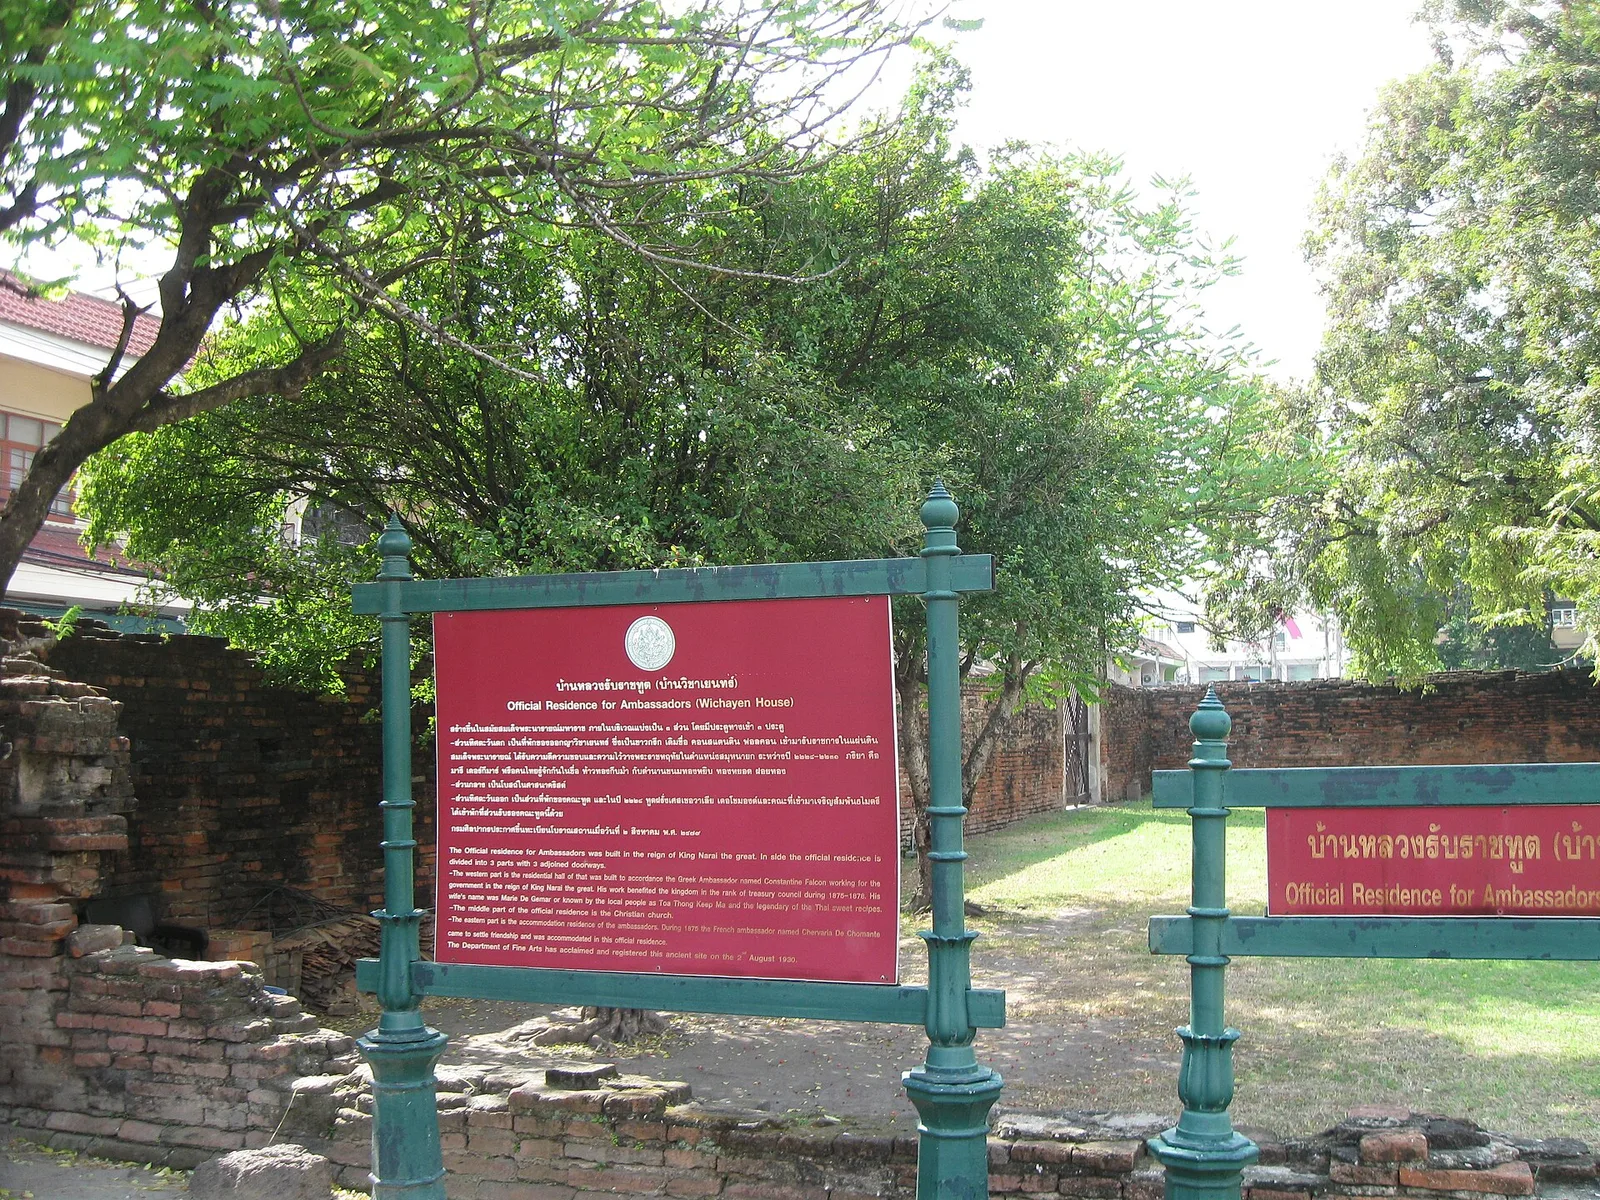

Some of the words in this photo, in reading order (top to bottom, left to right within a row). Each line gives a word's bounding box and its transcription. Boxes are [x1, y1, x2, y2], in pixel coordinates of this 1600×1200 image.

[556, 677, 651, 694] บ้านหลวงรับราชทูต
[655, 677, 738, 690] (บ้านวิชาเยนทร์)
[506, 700, 542, 711] Official
[545, 700, 598, 711] Residence
[601, 700, 617, 710] for
[620, 698, 692, 710] Ambassadors
[695, 697, 751, 710] (Wichayen
[755, 697, 794, 708] House)
[449, 846, 463, 854] The
[464, 847, 489, 855] Official
[525, 848, 536, 856] for
[538, 848, 586, 857] Ambassadors
[647, 851, 666, 860] reign
[678, 851, 696, 860] King
[735, 853, 757, 861] great.
[770, 853, 787, 861] side
[804, 853, 831, 861] official
[1307, 820, 1541, 874] บ้านหลวงรับราชทูต
[449, 858, 473, 866] divided
[496, 860, 514, 868] parts
[540, 860, 569, 869] adjoined
[571, 861, 607, 870] doorways.
[490, 871, 502, 879] part
[677, 875, 696, 883] Greek
[699, 876, 738, 884] Ambassador
[805, 878, 827, 886] Falcon
[829, 879, 856, 887] working
[448, 882, 484, 890] government
[504, 883, 520, 891] reign
[530, 884, 545, 892] King
[546, 884, 563, 892] Narai
[576, 886, 594, 894] great.
[627, 886, 656, 894] benefited
[671, 888, 699, 897] kingdom
[804, 891, 826, 900] during
[869, 892, 881, 900] His
[1285, 881, 1344, 906] Official
[1352, 882, 1442, 907] Residence
[1449, 883, 1475, 907] for
[448, 892, 466, 900] wife's
[500, 894, 518, 902] Marie
[624, 899, 647, 907] people
[673, 900, 694, 909] Thong
[492, 906, 506, 914] part
[531, 907, 553, 915] official
[556, 908, 589, 916] residence
[614, 910, 645, 918] Christian
[648, 911, 674, 919] church.
[519, 919, 565, 927] accommodation
[566, 920, 596, 928] residence
[617, 922, 659, 931] ambassadors.
[490, 931, 519, 940] friendship
[547, 934, 592, 943] accommodated
[614, 936, 635, 944] official
[636, 938, 669, 946] residence.
[462, 942, 501, 951] Department
[559, 946, 594, 955] acclaimed
[612, 949, 648, 958] registered
[650, 950, 663, 958] this
